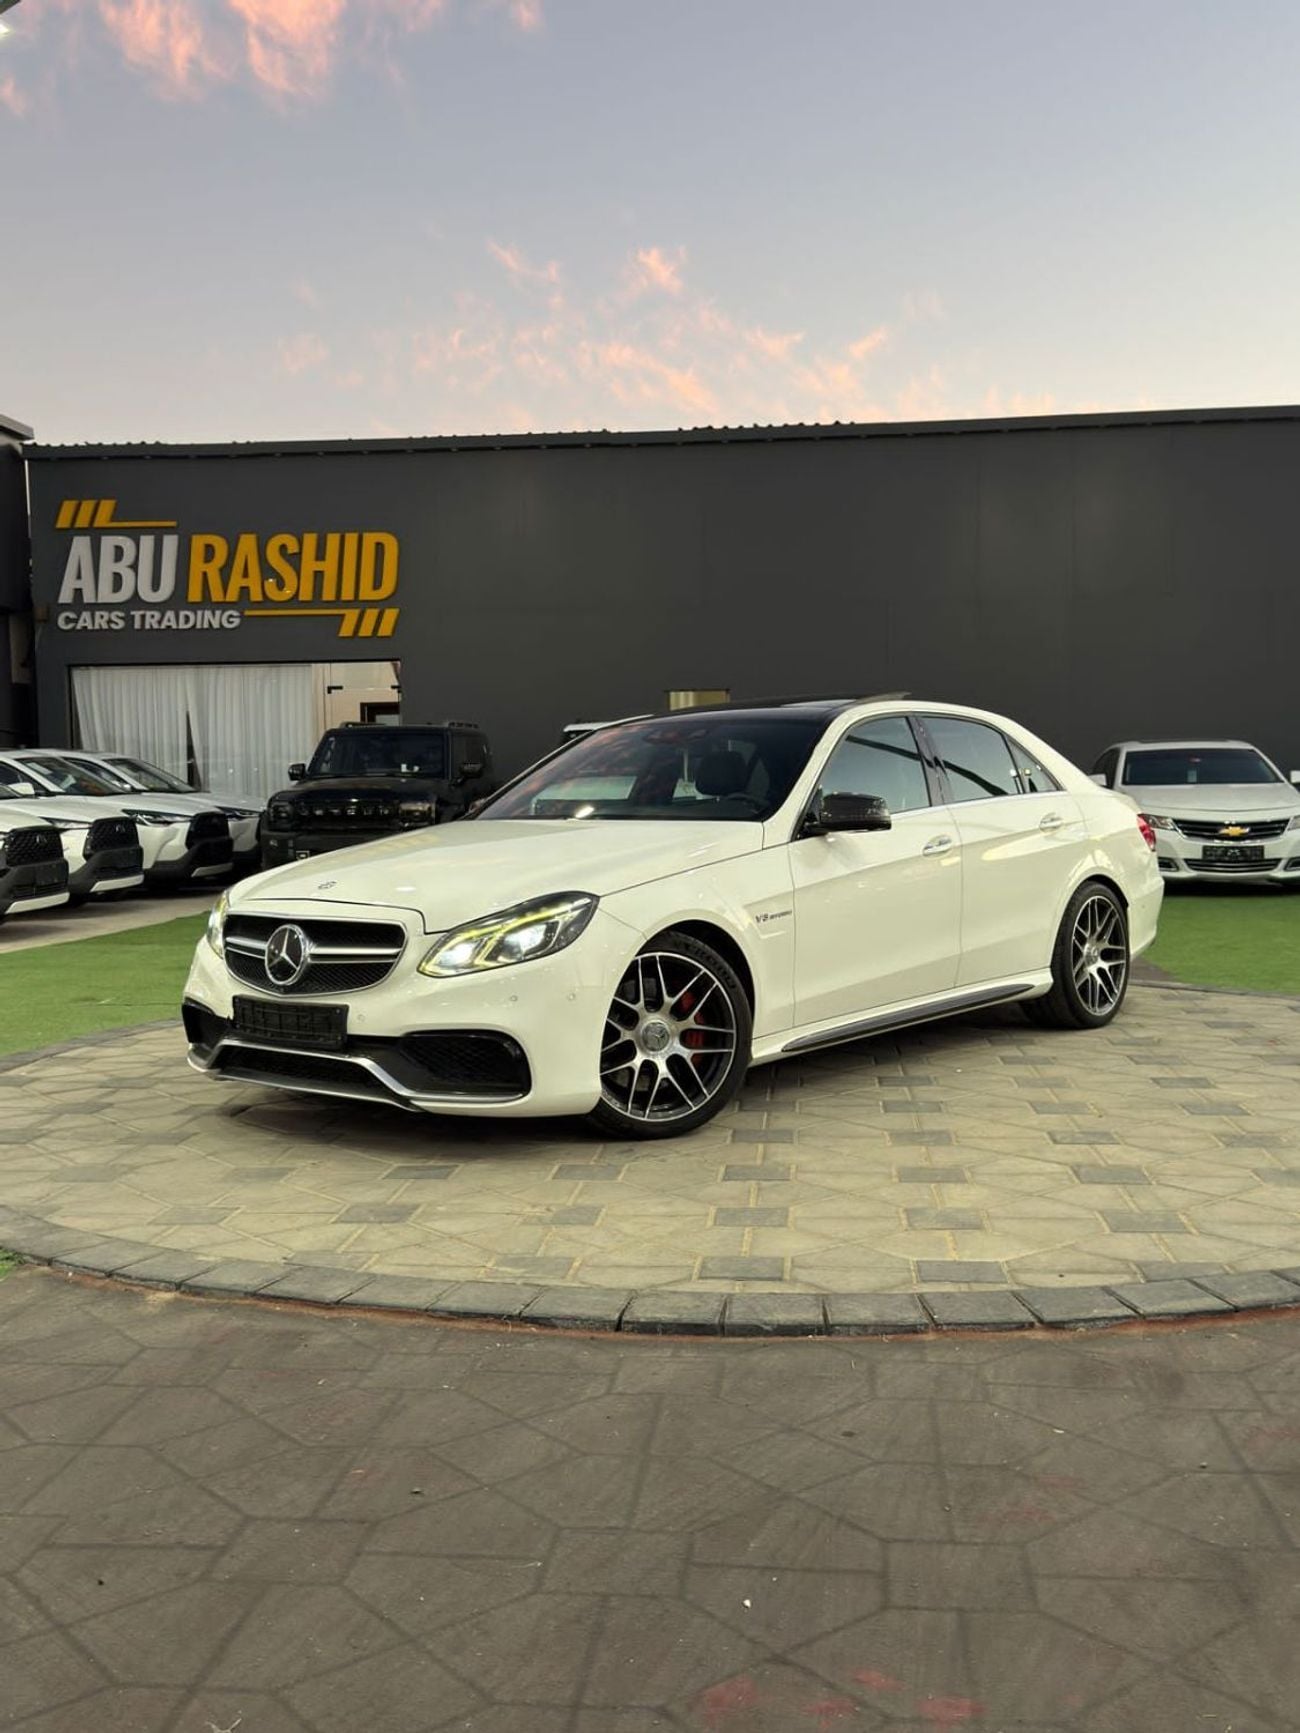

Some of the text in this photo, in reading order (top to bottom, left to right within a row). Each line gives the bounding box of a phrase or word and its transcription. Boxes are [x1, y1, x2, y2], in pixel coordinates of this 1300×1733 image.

[58, 533, 399, 604] ABU RASHID
[57, 609, 241, 630] CARS TRADING
